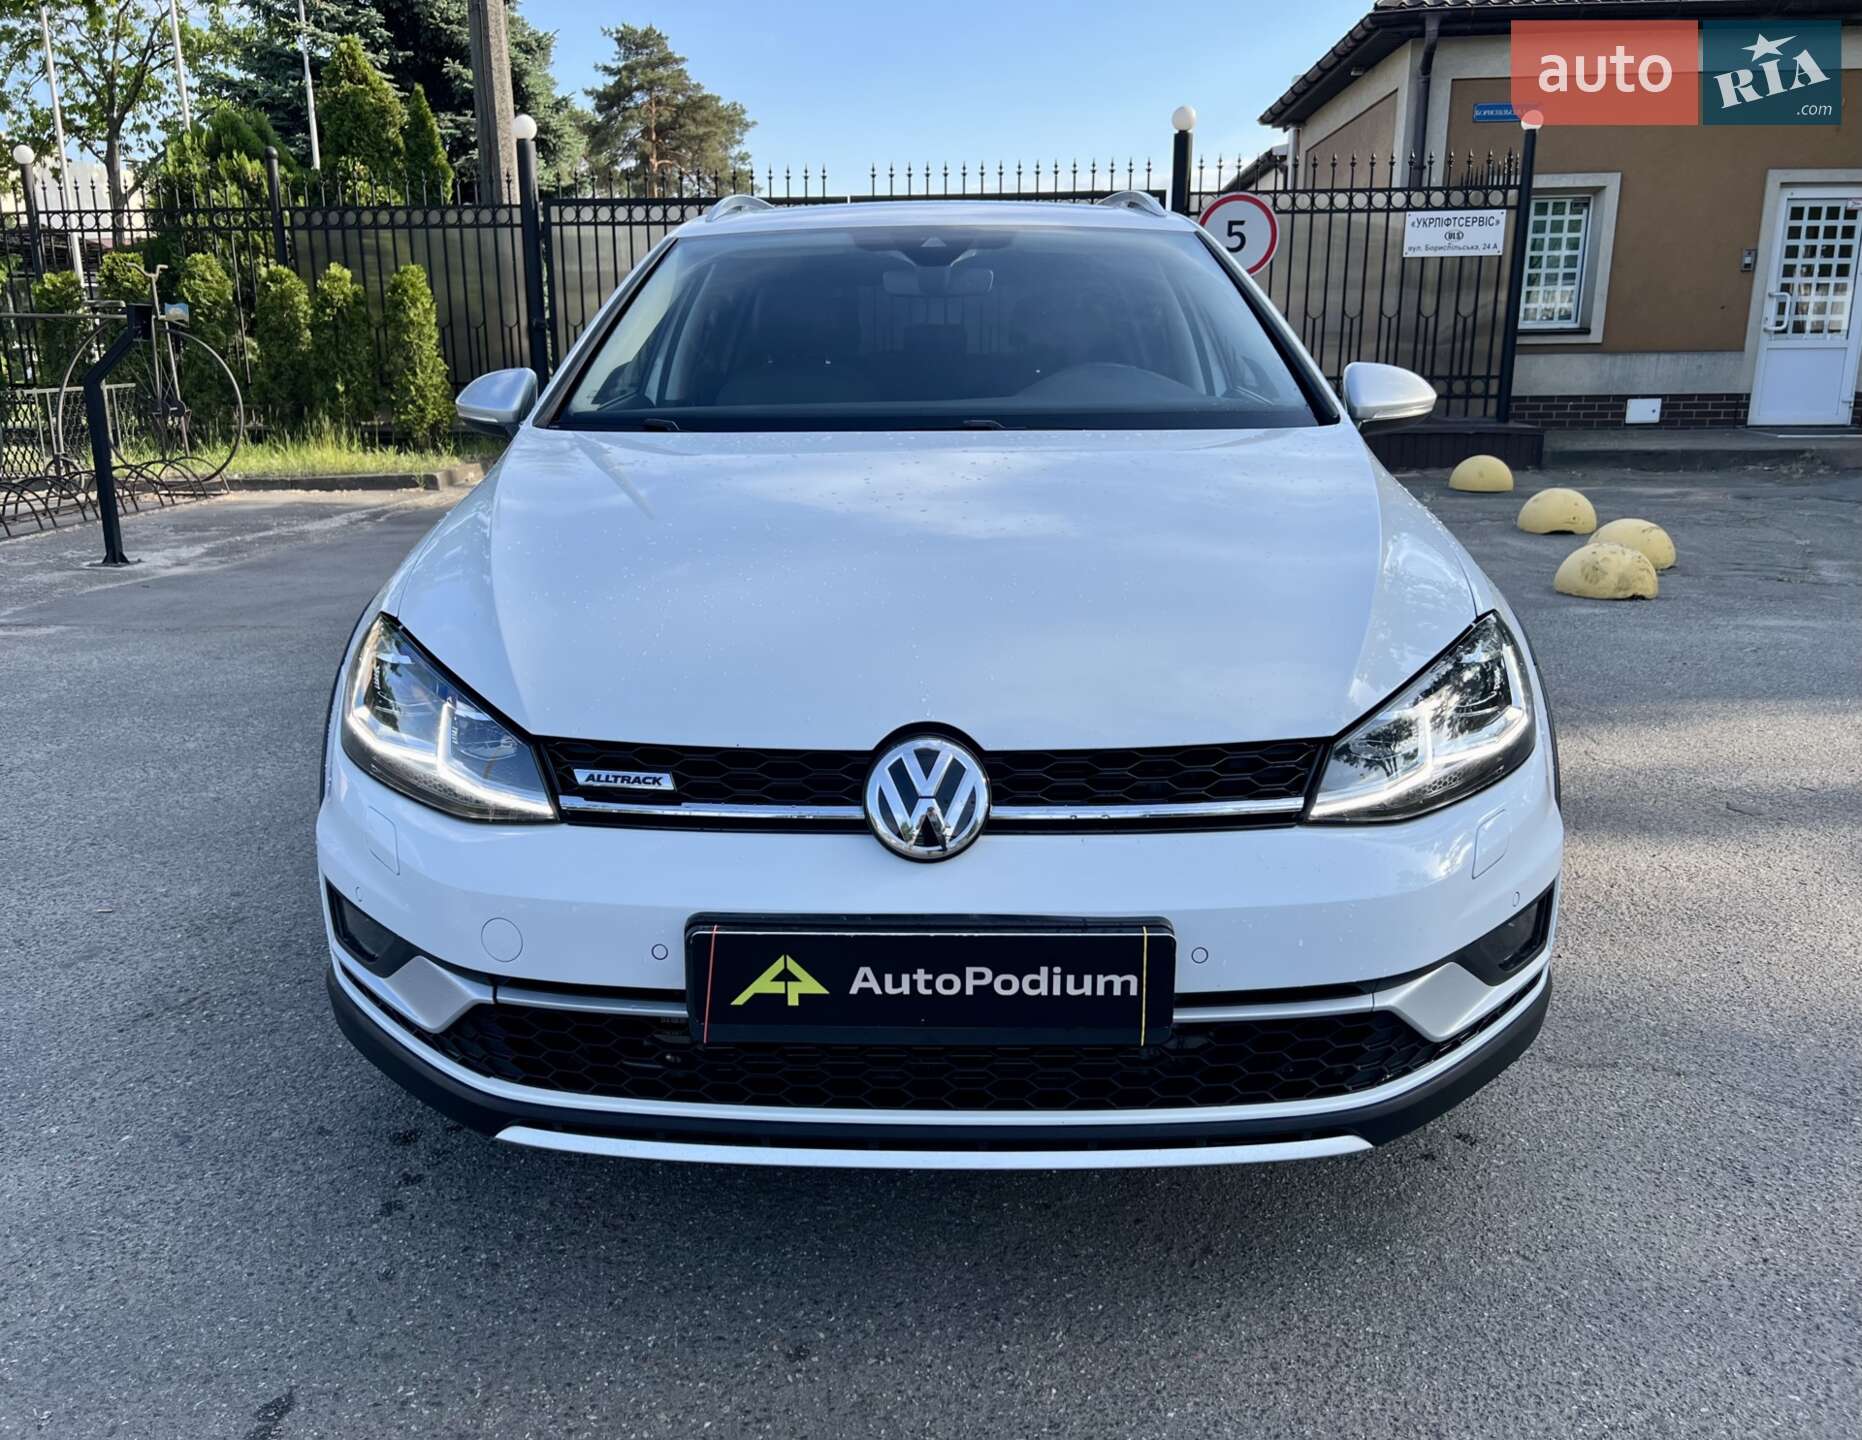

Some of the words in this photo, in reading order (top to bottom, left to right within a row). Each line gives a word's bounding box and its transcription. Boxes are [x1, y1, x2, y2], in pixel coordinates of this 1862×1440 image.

[1226, 220, 1246, 253] 5
[584, 773, 663, 786] ALLTRACK
[849, 966, 1138, 996] AutoPodium
